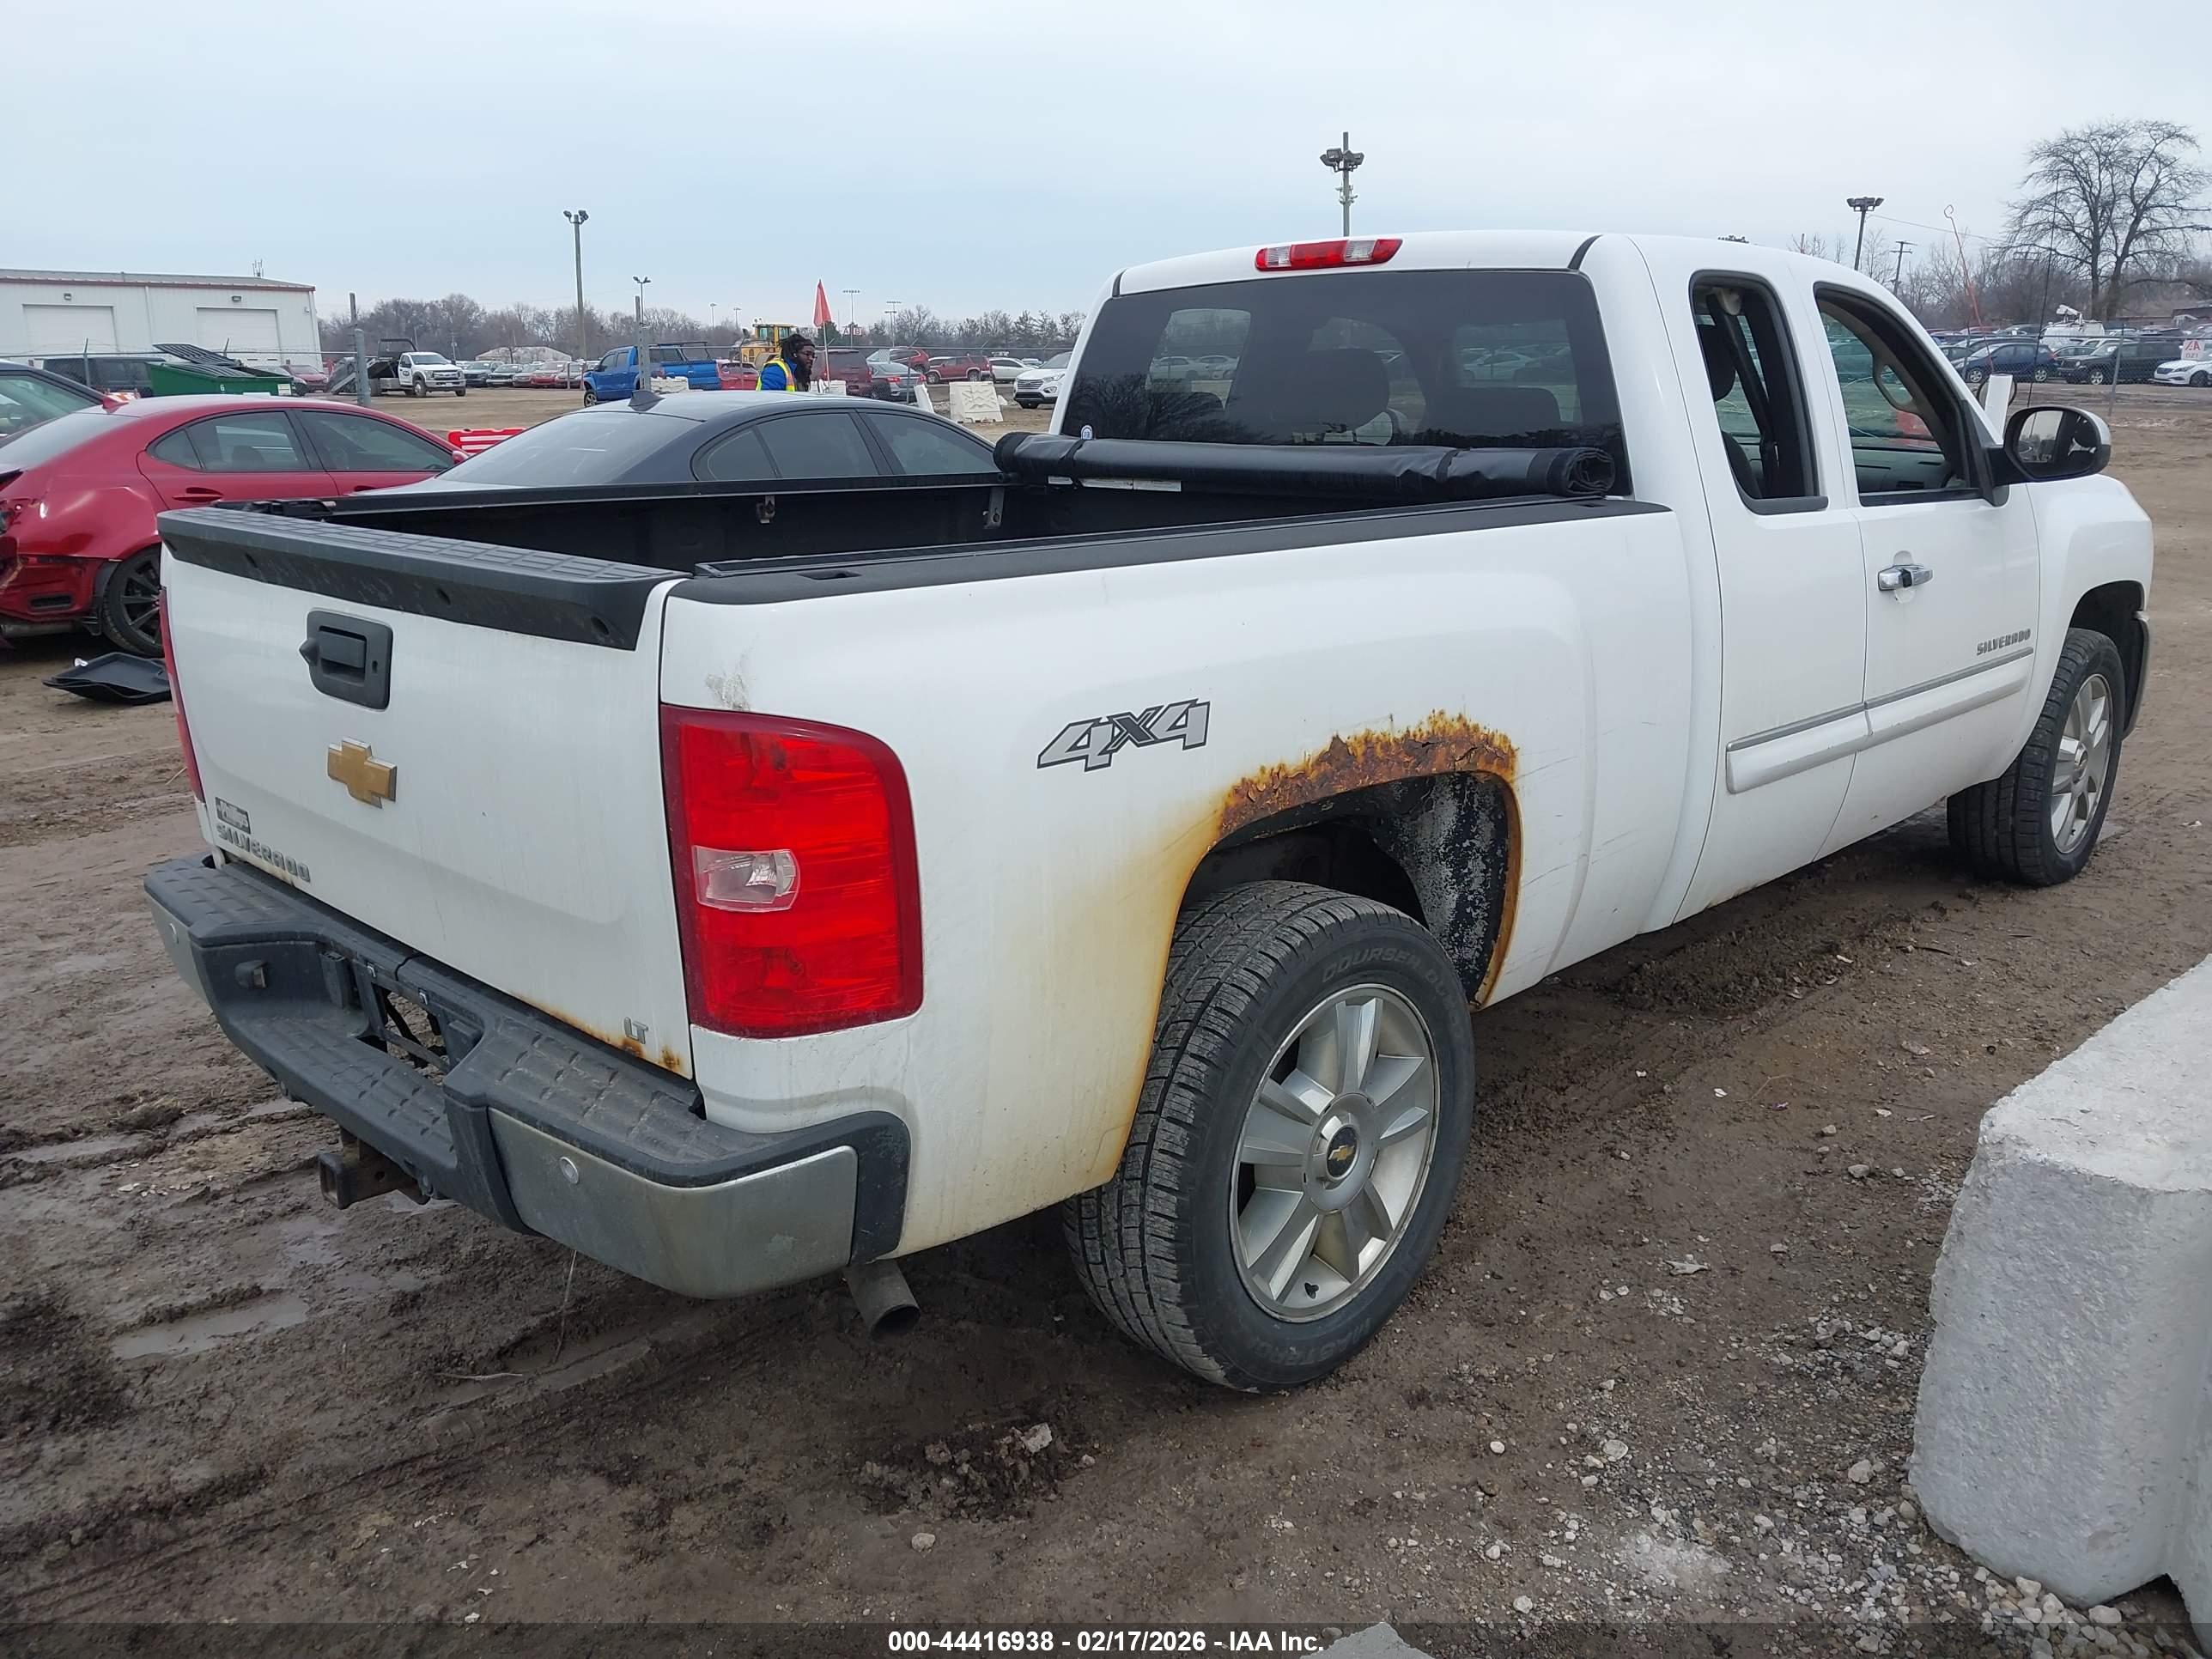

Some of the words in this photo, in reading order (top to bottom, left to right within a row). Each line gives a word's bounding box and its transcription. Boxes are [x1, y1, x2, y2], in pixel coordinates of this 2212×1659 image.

[1977, 628, 2031, 656] SILVERADO
[216, 823, 311, 884] SILVERADO
[623, 1016, 649, 1045] LT
